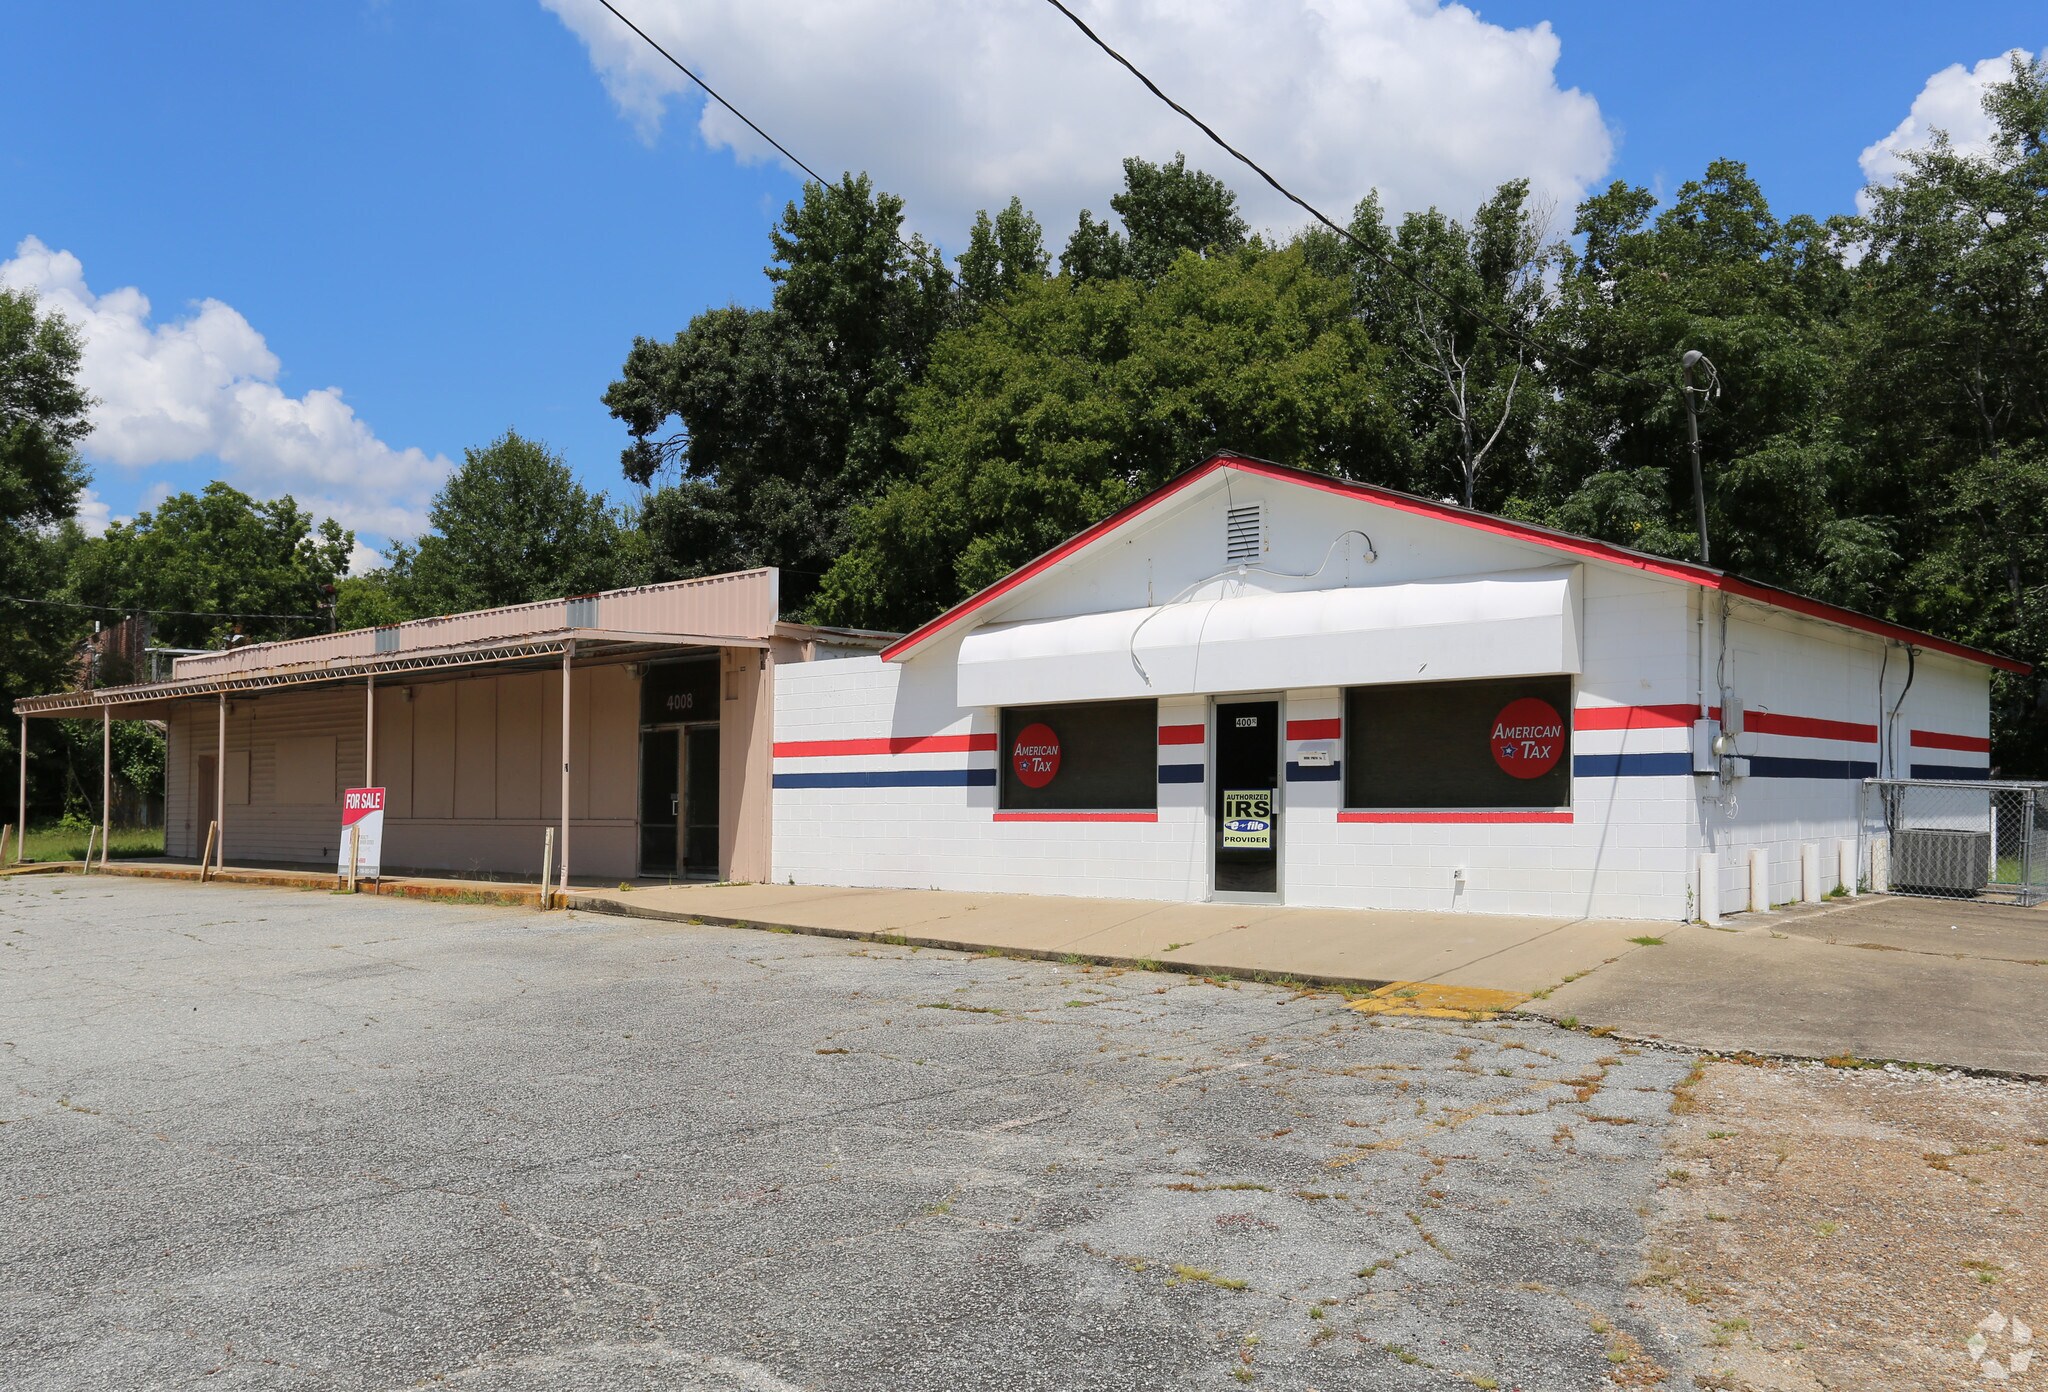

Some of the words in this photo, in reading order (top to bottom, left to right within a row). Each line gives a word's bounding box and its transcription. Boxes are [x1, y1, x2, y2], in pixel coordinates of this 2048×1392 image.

[667, 692, 693, 710] 4008
[1492, 723, 1561, 740] AMERICAN
[1014, 743, 1058, 756] AMERICAN
[1521, 741, 1551, 759] TAX
[1032, 757, 1052, 772] TAX
[346, 793, 360, 809] FOR
[361, 793, 381, 809] SALE
[1226, 801, 1270, 818] IRS
